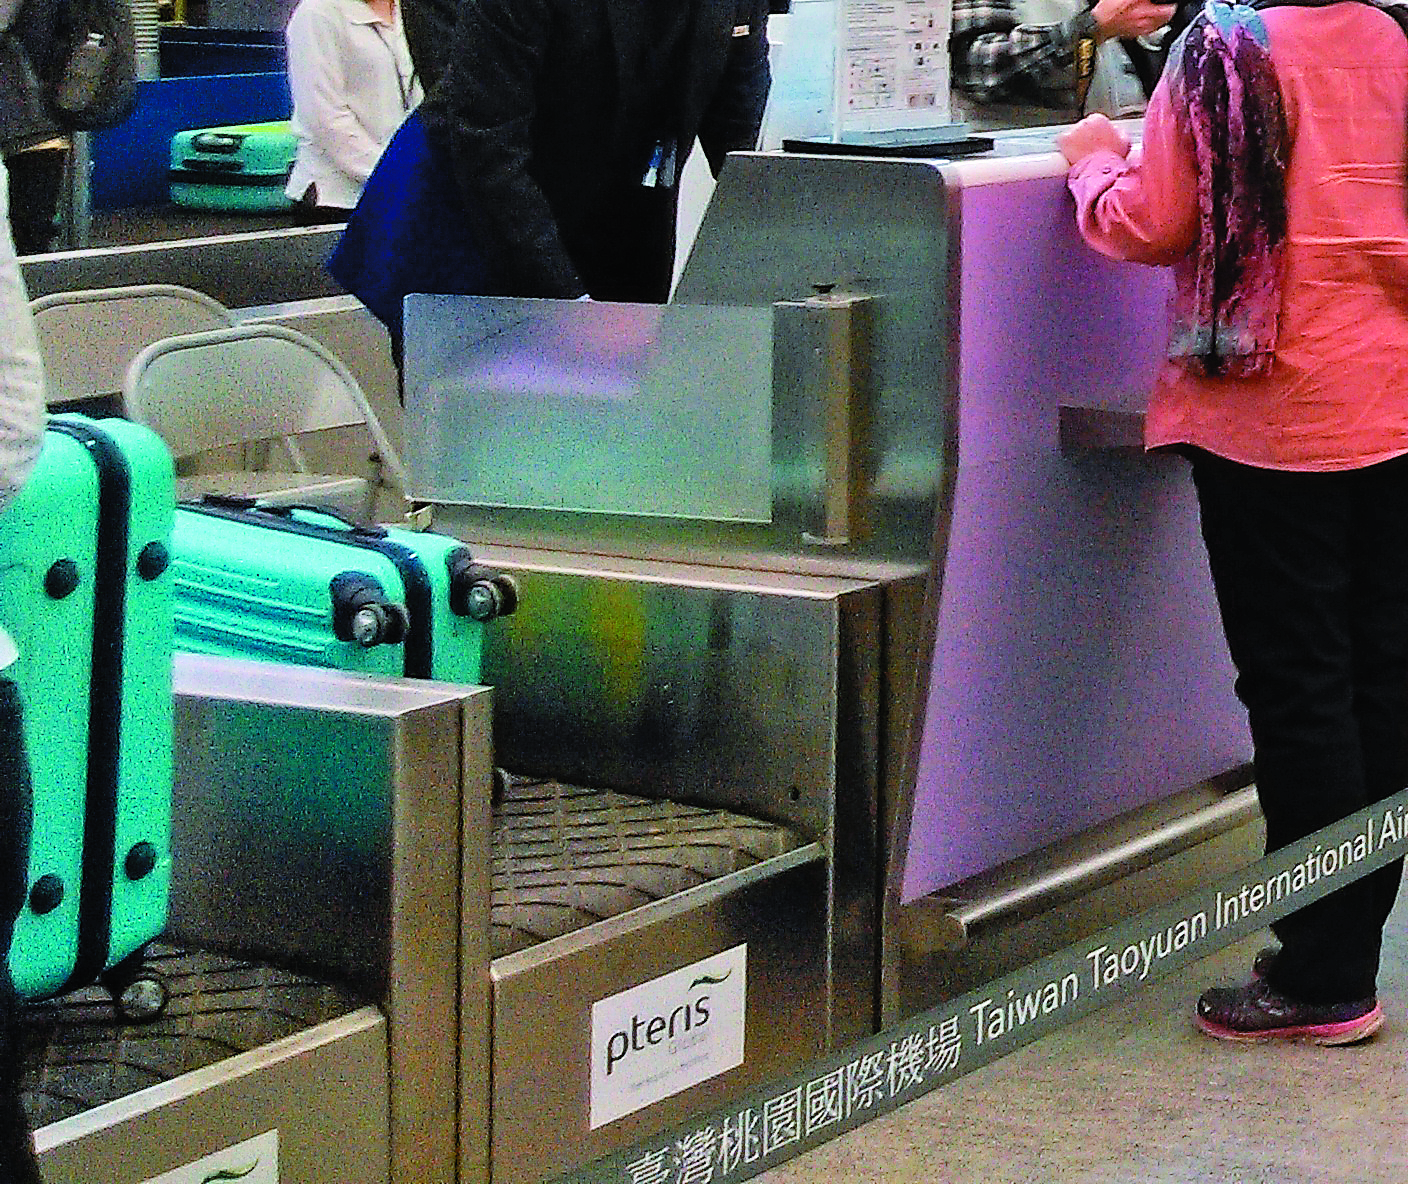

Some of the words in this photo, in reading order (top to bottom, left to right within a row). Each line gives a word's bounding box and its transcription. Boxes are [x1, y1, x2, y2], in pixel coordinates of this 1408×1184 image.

[968, 971, 1079, 1046] Taiwan
[1085, 912, 1207, 989] Taoyuan
[1214, 818, 1375, 930] International
[606, 995, 711, 1076] pteris
